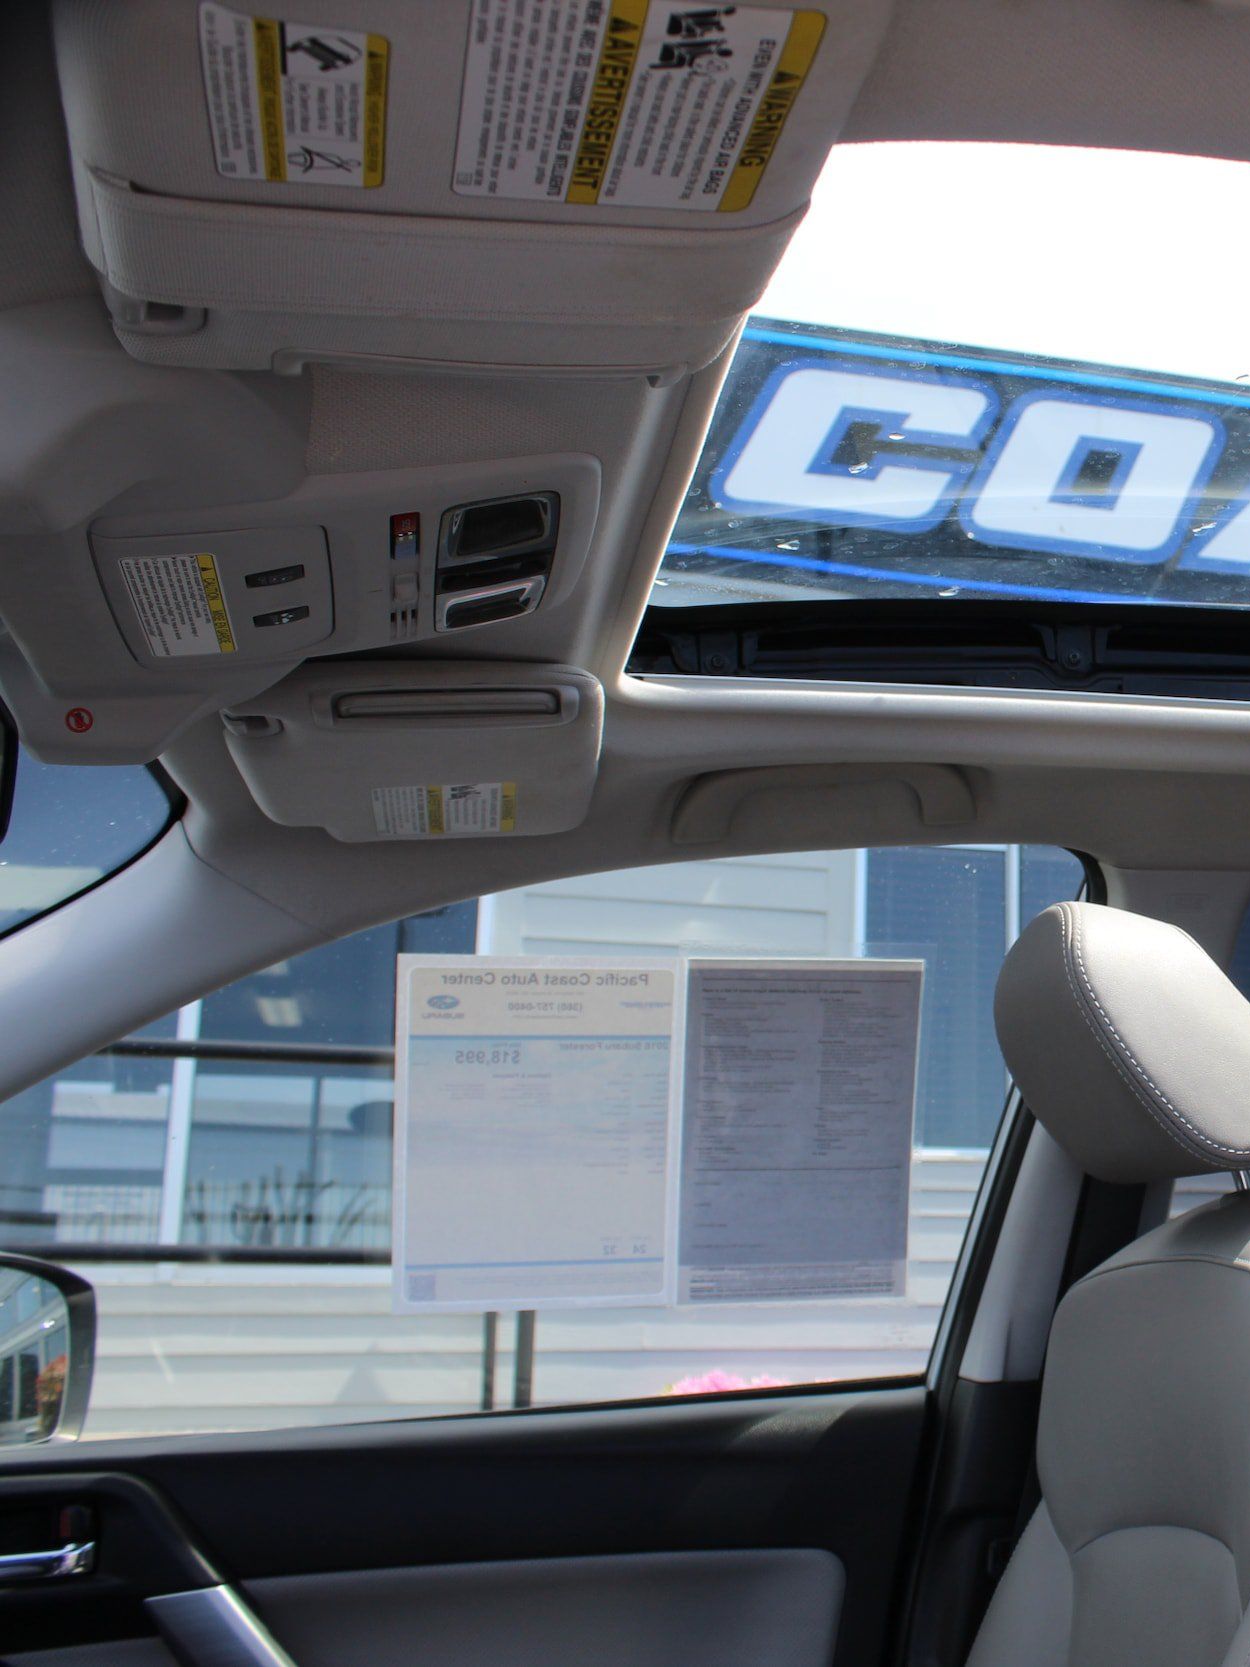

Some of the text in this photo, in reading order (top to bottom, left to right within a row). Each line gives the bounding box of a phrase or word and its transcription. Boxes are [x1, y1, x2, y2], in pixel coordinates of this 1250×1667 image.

[567, 35, 638, 189] AVERTISSEMENT
[701, 39, 778, 194] EVEN WITH ADVANCED AIR BAGS
[737, 85, 794, 168] WARNING
